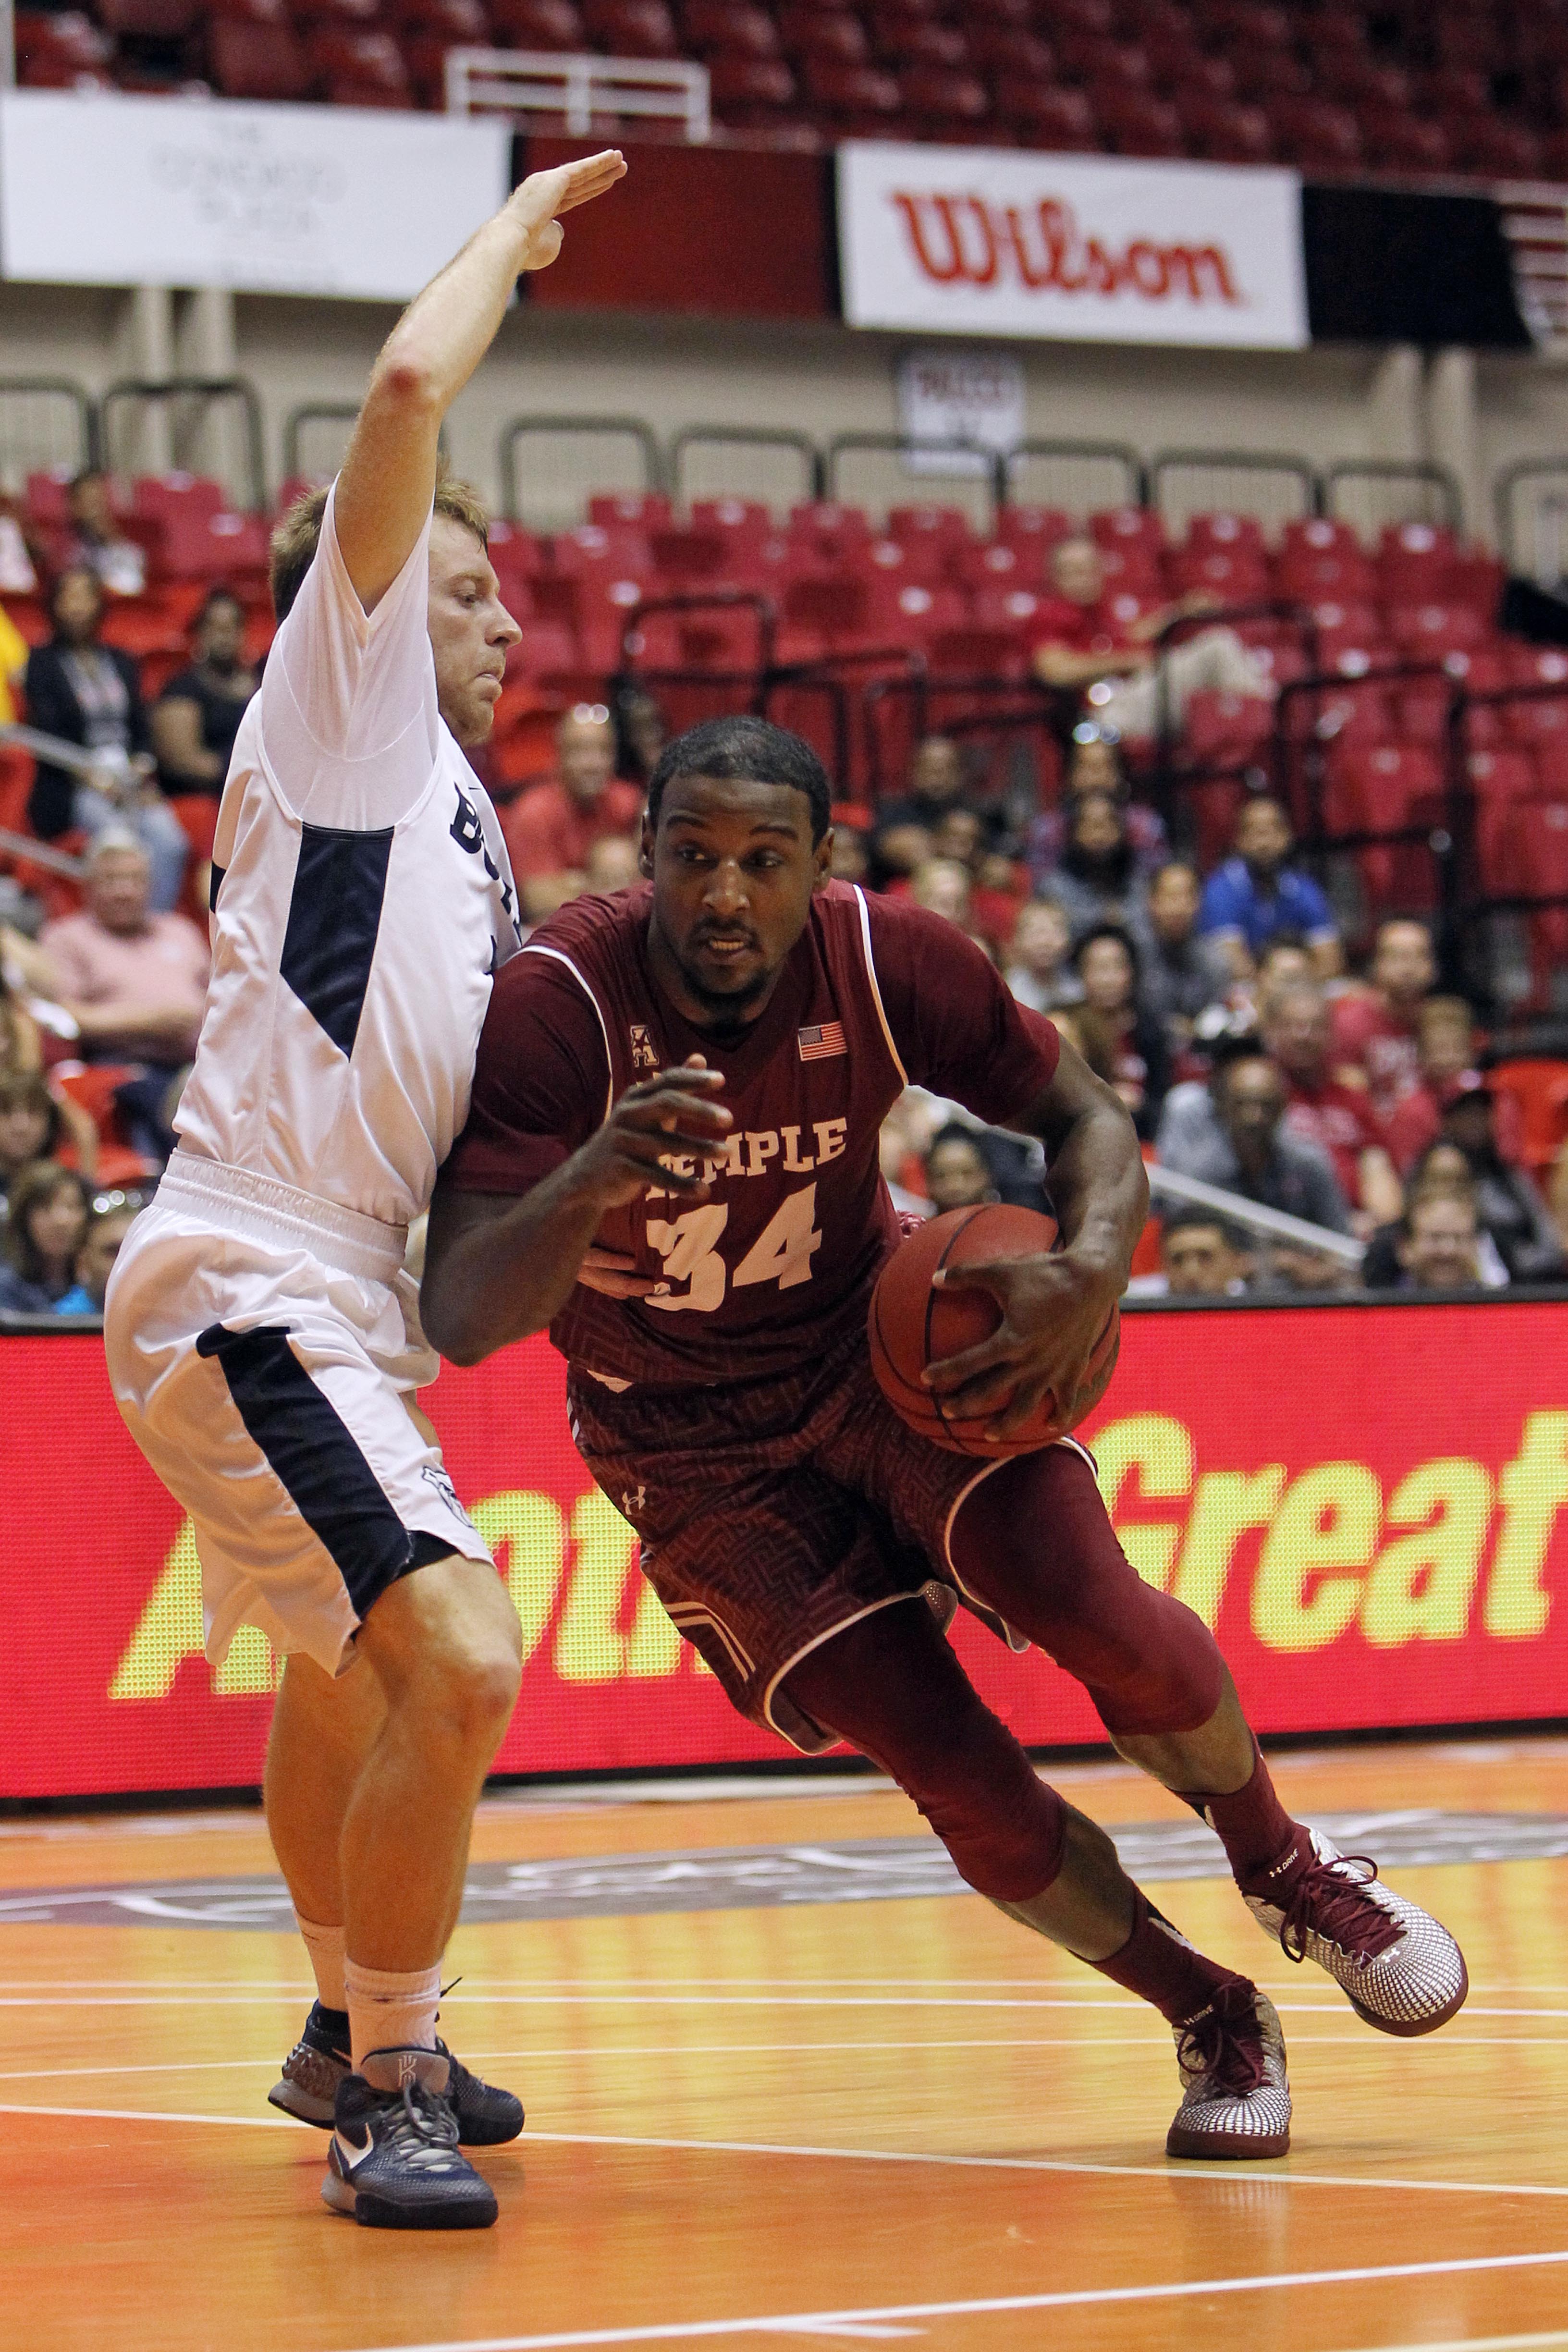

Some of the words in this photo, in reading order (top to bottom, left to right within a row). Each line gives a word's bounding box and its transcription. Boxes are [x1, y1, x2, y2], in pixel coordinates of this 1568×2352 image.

[890, 191, 1244, 311] Wilson
[645, 1117, 847, 1201] EMPLE
[644, 1181, 822, 1312] 34
[1087, 1410, 1568, 1653] Great
[1282, 1848, 1299, 1870] DRIVE
